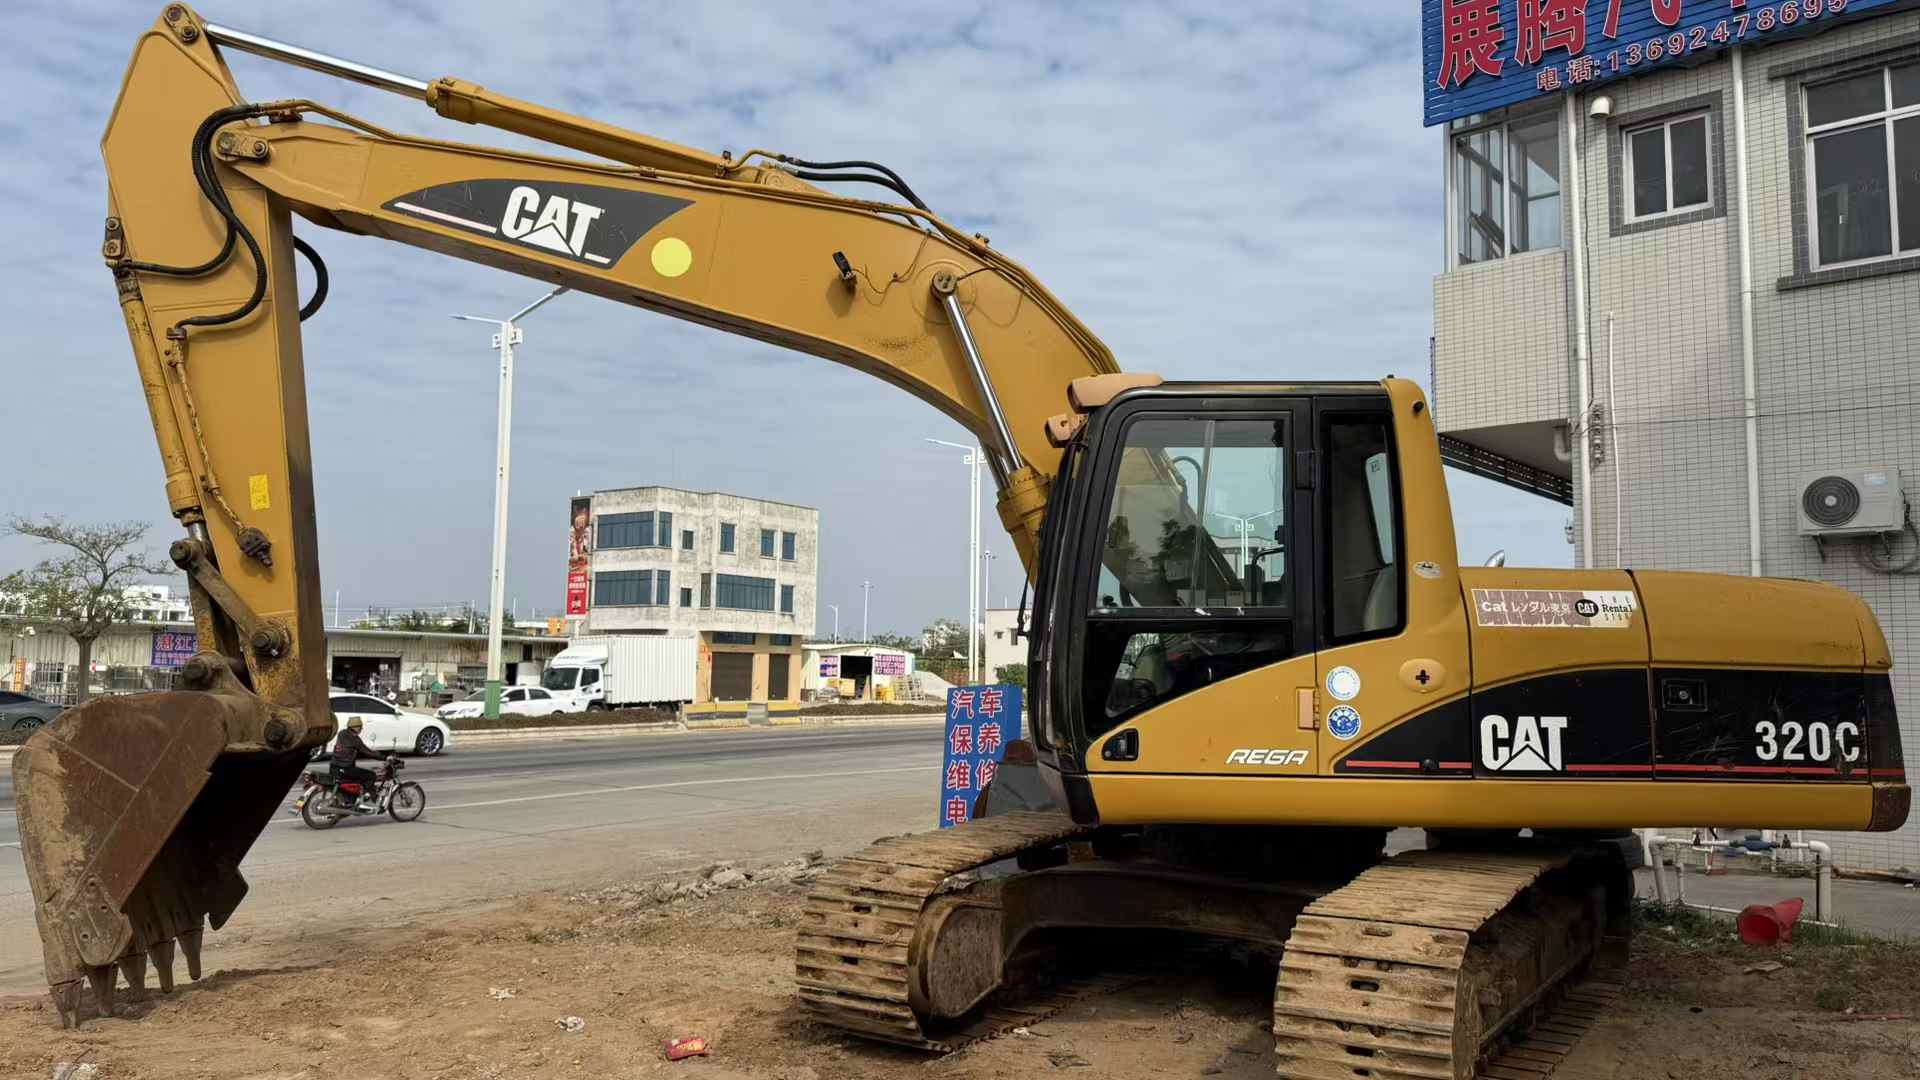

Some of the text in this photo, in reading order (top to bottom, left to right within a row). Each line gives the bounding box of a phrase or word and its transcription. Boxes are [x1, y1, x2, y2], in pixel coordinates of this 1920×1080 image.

[501, 186, 601, 256] CAT
[1482, 601, 1508, 612] Cat
[1577, 602, 1595, 614] CAT
[1602, 604, 1633, 613] Rental
[952, 687, 1002, 719] 汽车
[950, 722, 1001, 755] 保养
[1480, 714, 1568, 771] CAT
[1755, 720, 1860, 762] 320C
[1226, 749, 1309, 765] REGA
[946, 759, 998, 791] 维修
